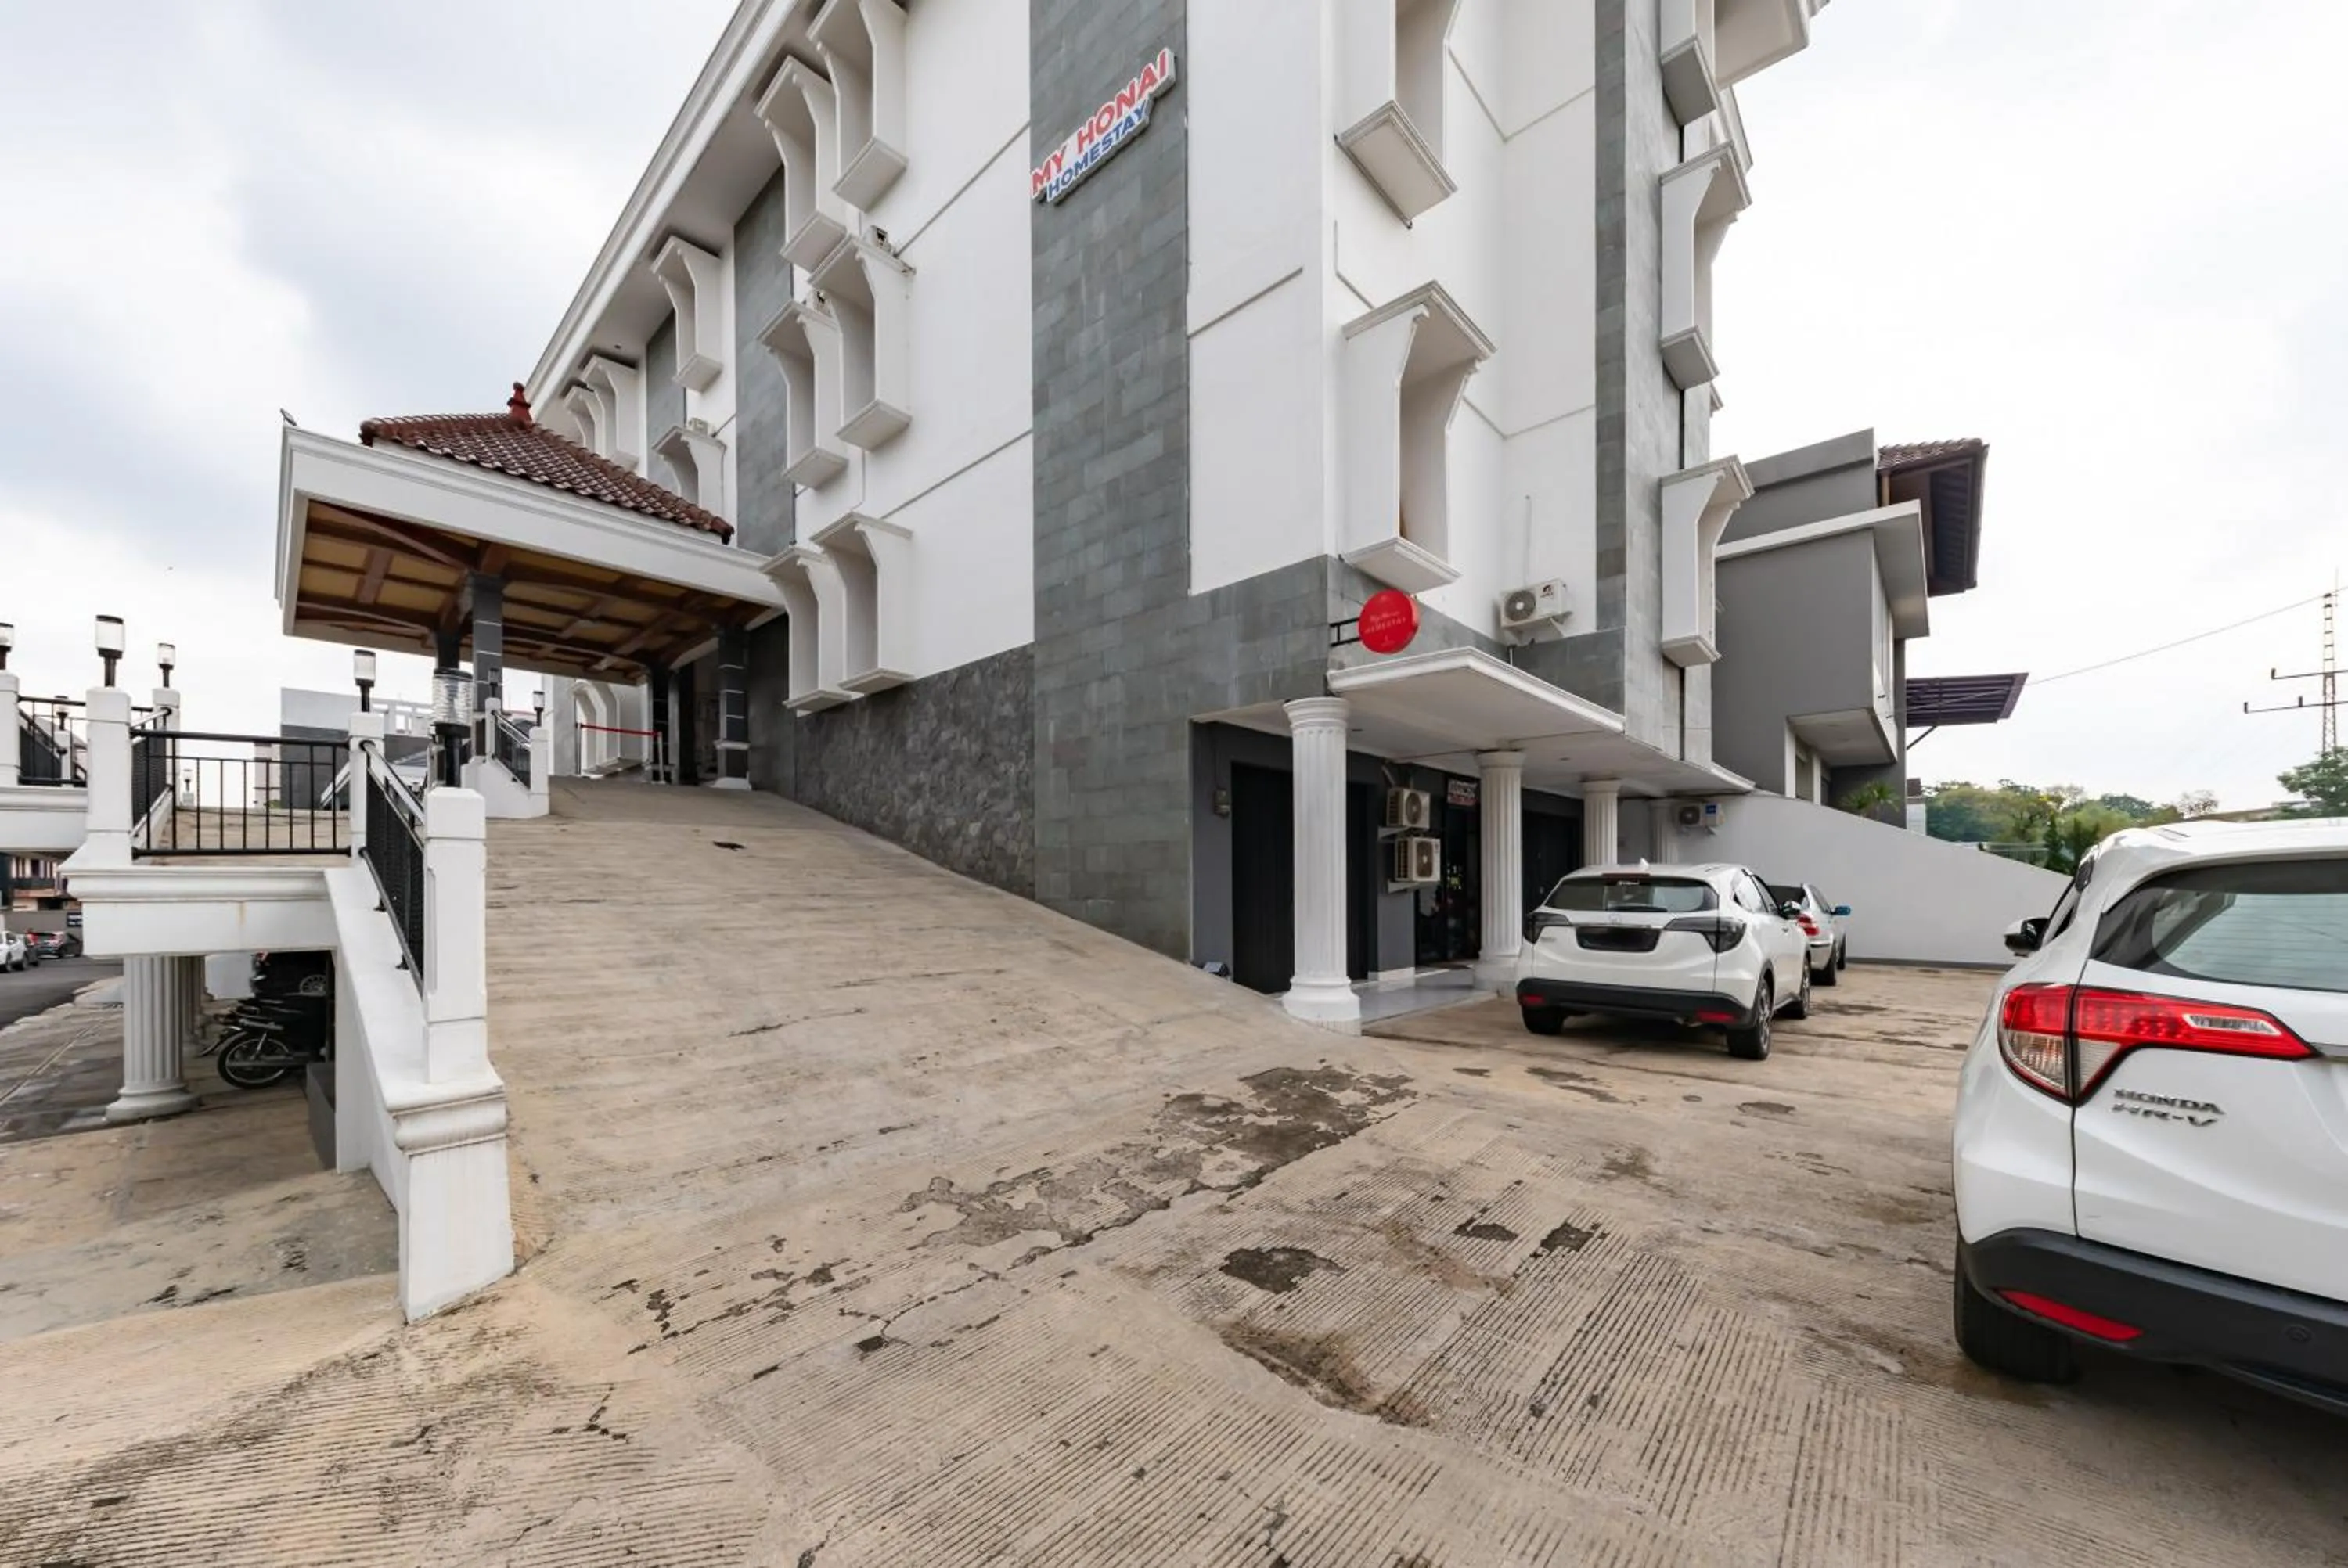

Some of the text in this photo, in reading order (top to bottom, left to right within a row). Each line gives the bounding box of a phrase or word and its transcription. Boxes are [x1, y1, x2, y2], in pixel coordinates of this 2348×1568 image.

[1032, 51, 1167, 193] MY HONAI
[1049, 102, 1146, 197] HOMESTAY
[2112, 1104, 2218, 1127] HR-V
[2114, 1089, 2226, 1114] HONDA
